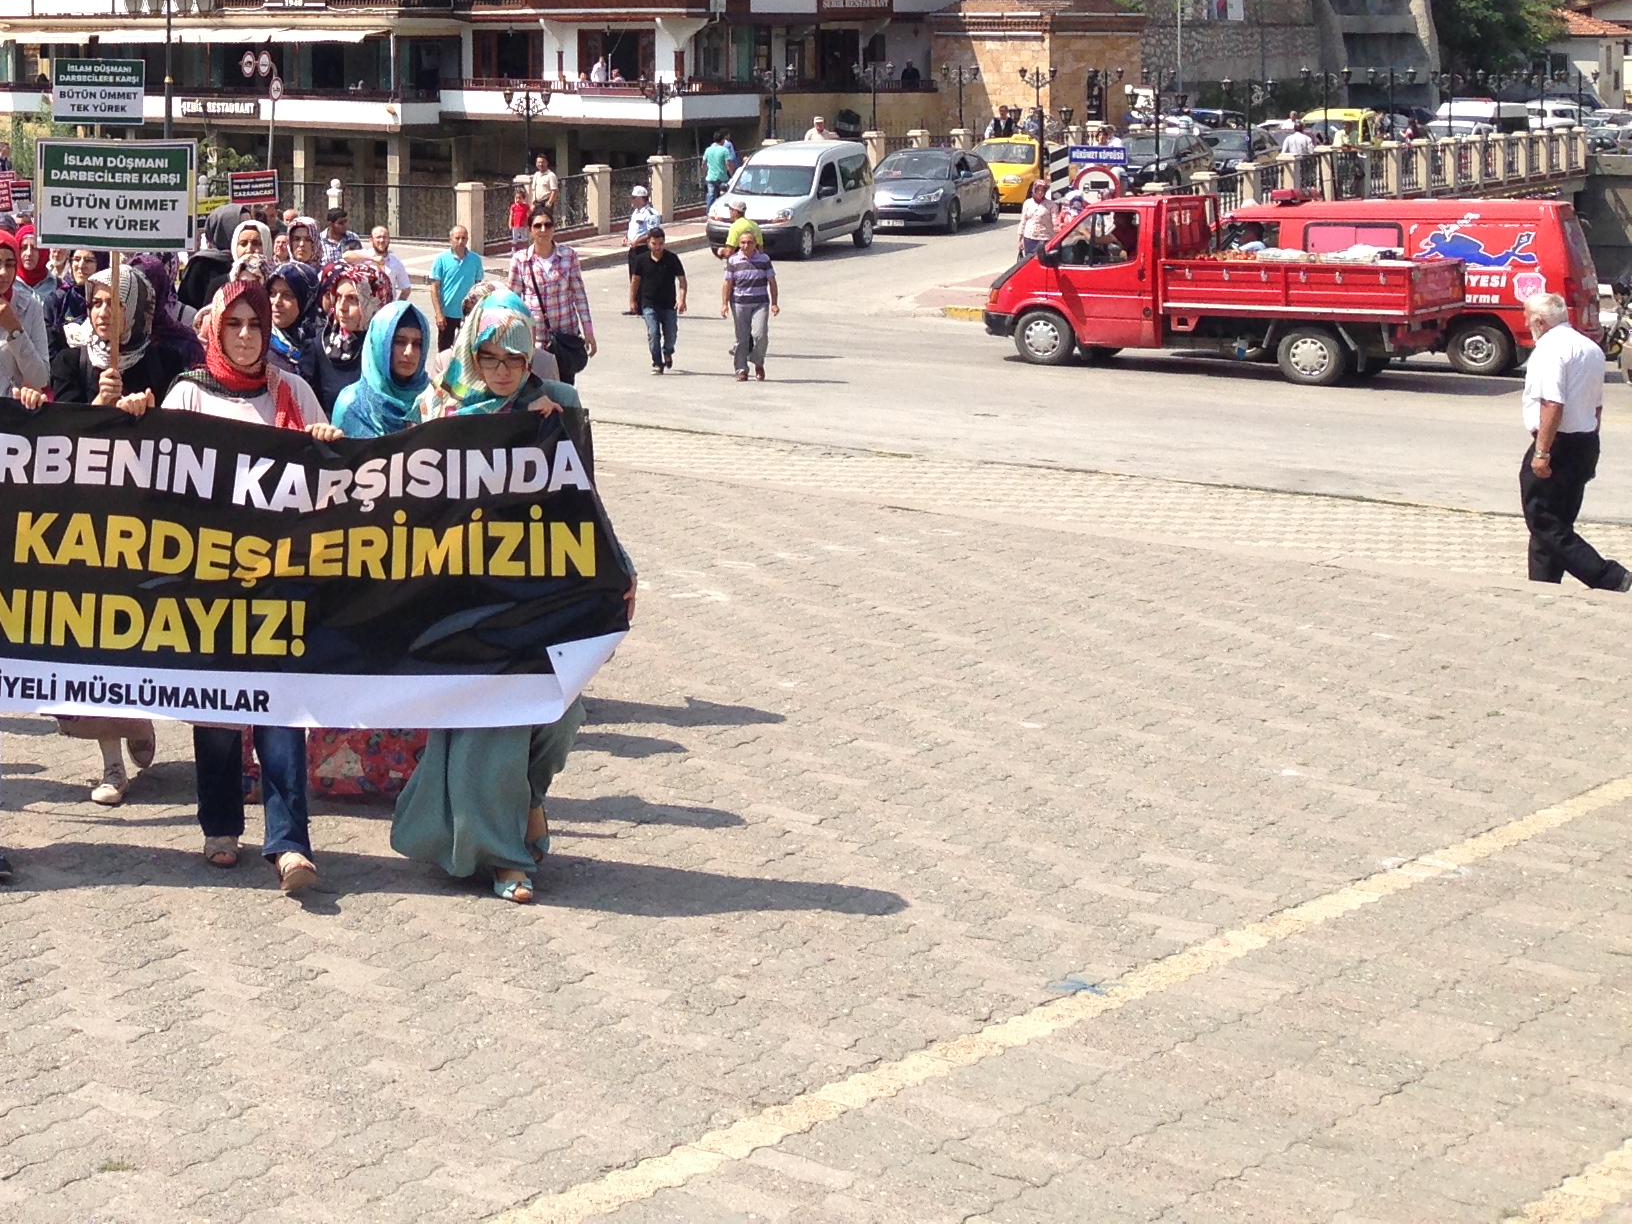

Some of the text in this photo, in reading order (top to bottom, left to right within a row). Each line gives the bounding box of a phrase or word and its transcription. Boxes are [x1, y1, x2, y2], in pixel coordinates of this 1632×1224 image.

[59, 72, 139, 84] DARBECİLERE KARŞI
[67, 63, 132, 75] İSLAM DÜŞMANI
[59, 88, 138, 100] BÜTÜN ÜMMET
[70, 102, 127, 113] TEK YÜREK
[64, 152, 168, 170] İSLAM DÜŞMANI
[51, 168, 180, 186] DARBECİLERE KARŞI
[50, 191, 110, 210] BÜTÜN
[115, 194, 179, 212] ÜMMET
[68, 215, 160, 232] TEK YÜREK
[232, 440, 590, 513] KARŞISINDA
[14, 504, 596, 587] KARDEŞLERİMİZİN
[64, 672, 270, 713] MÜSLÜMANLAR
